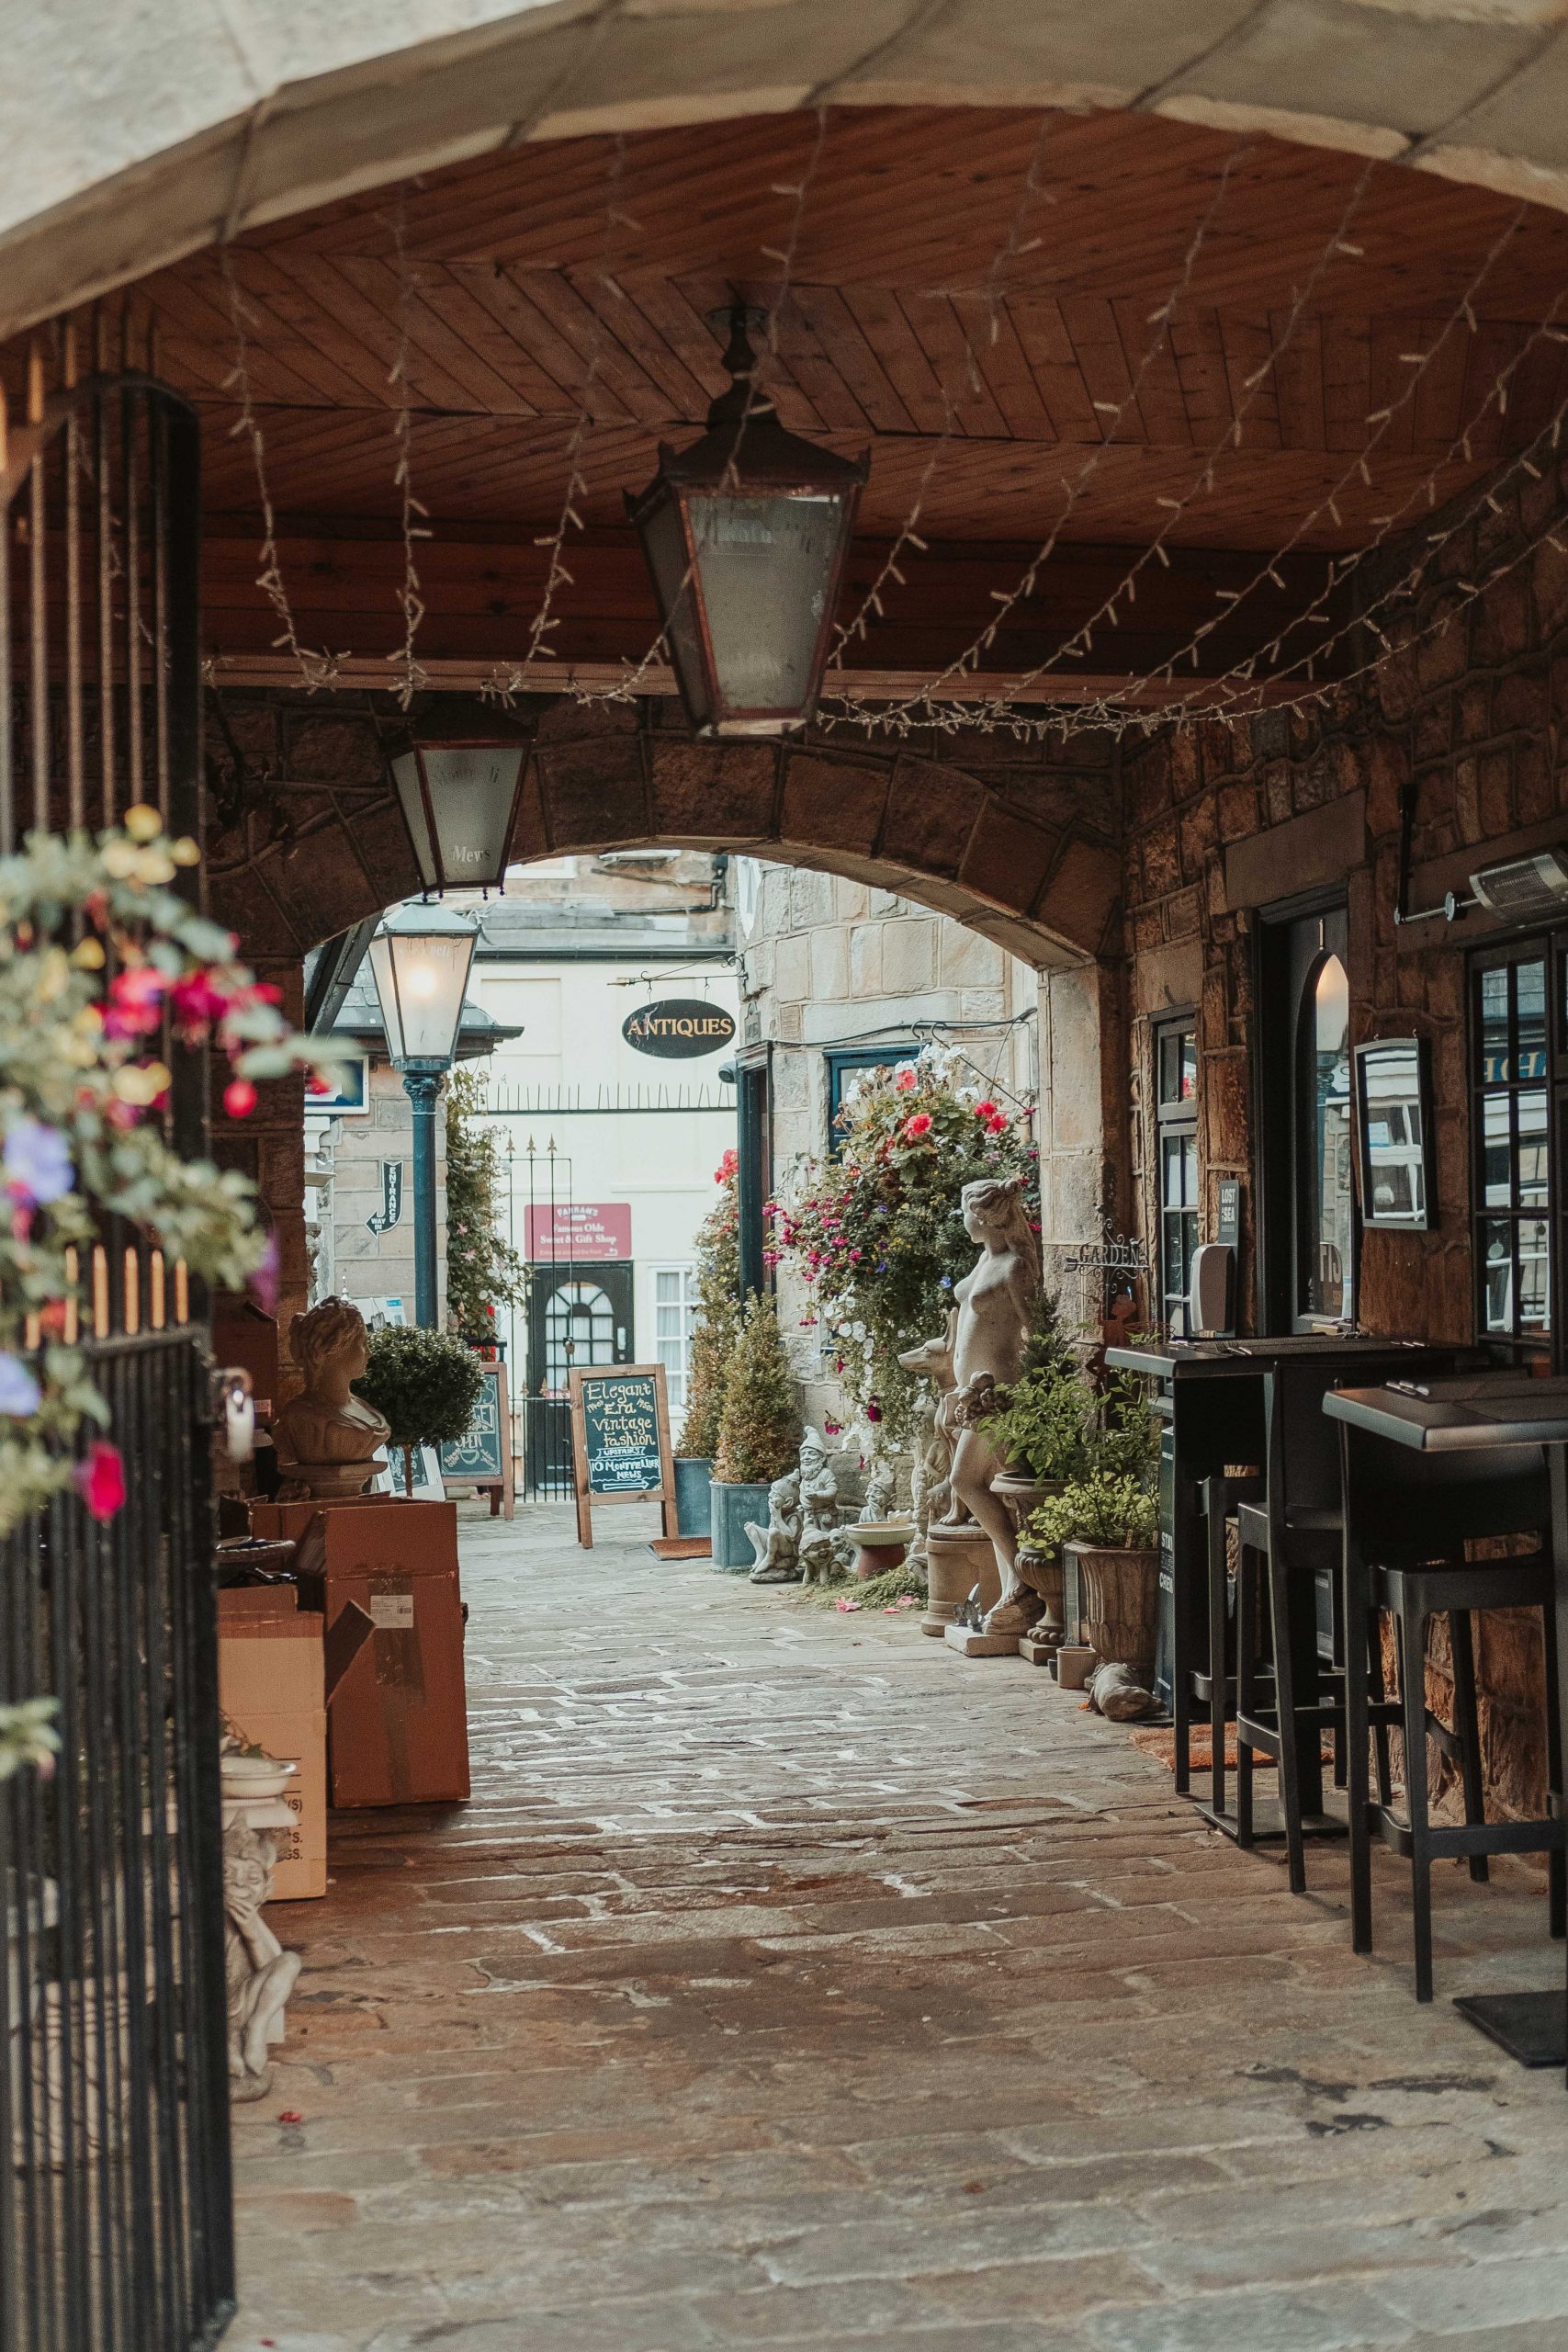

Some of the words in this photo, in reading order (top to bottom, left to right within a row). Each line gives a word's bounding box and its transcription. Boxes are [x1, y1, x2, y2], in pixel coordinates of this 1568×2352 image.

[452, 845, 491, 862] Mews
[626, 1017, 733, 1037] ANTIQUES
[1222, 1188, 1235, 1204] LOST
[584, 1223, 604, 1232] Olde
[575, 1234, 592, 1243] Gift
[595, 1234, 616, 1245] Shop
[1079, 1244, 1140, 1266] GARDEN
[587, 1382, 651, 1403] Elegant
[604, 1402, 637, 1415] Era
[592, 1416, 653, 1435] Vintage
[604, 1430, 656, 1447] Fashion
